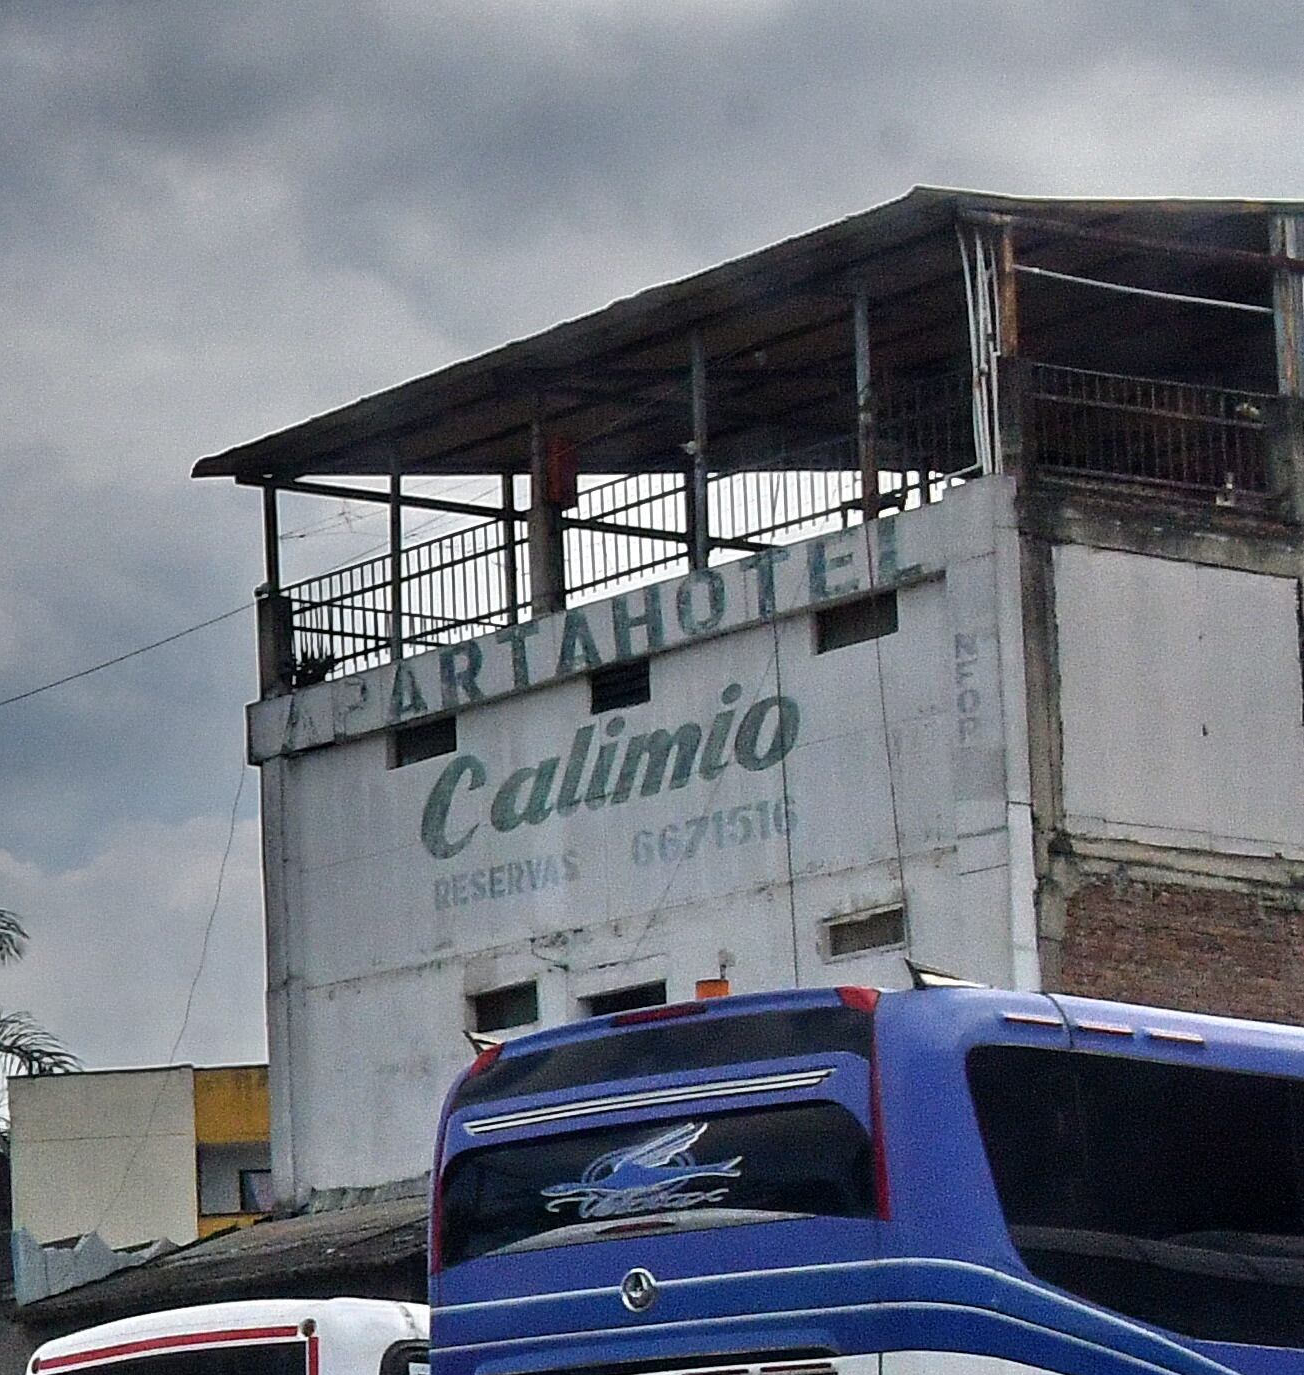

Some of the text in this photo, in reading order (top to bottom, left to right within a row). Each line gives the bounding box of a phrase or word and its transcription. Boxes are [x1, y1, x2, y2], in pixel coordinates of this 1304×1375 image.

[281, 513, 925, 756] APARTAHOTEL
[421, 682, 801, 860] Calimio
[433, 851, 582, 912] RESERVAS
